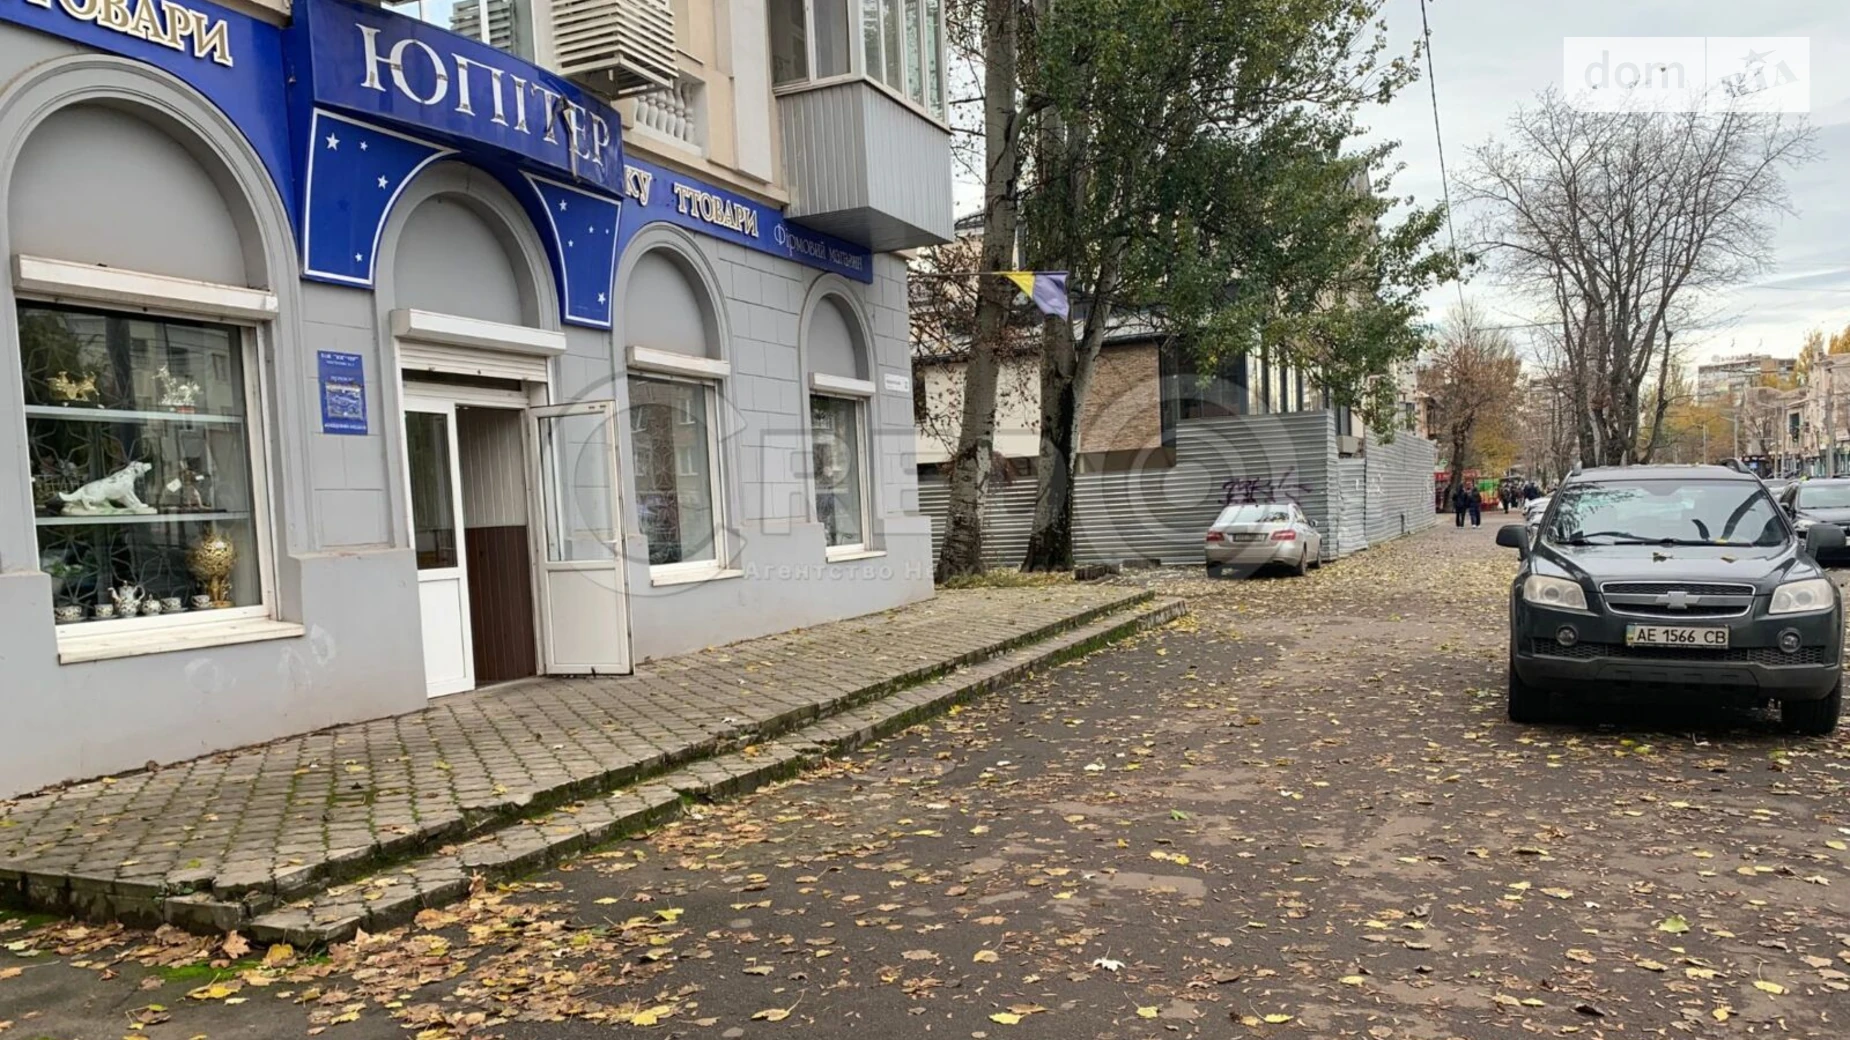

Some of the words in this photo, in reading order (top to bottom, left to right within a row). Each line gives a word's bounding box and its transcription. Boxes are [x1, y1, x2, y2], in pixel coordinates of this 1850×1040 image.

[26, 0, 233, 67] ВАРИ
[355, 23, 610, 166] ЮПІТЕР
[1636, 628, 1657, 642] AE
[1662, 629, 1696, 643] 1566
[1704, 630, 1726, 644] CB
